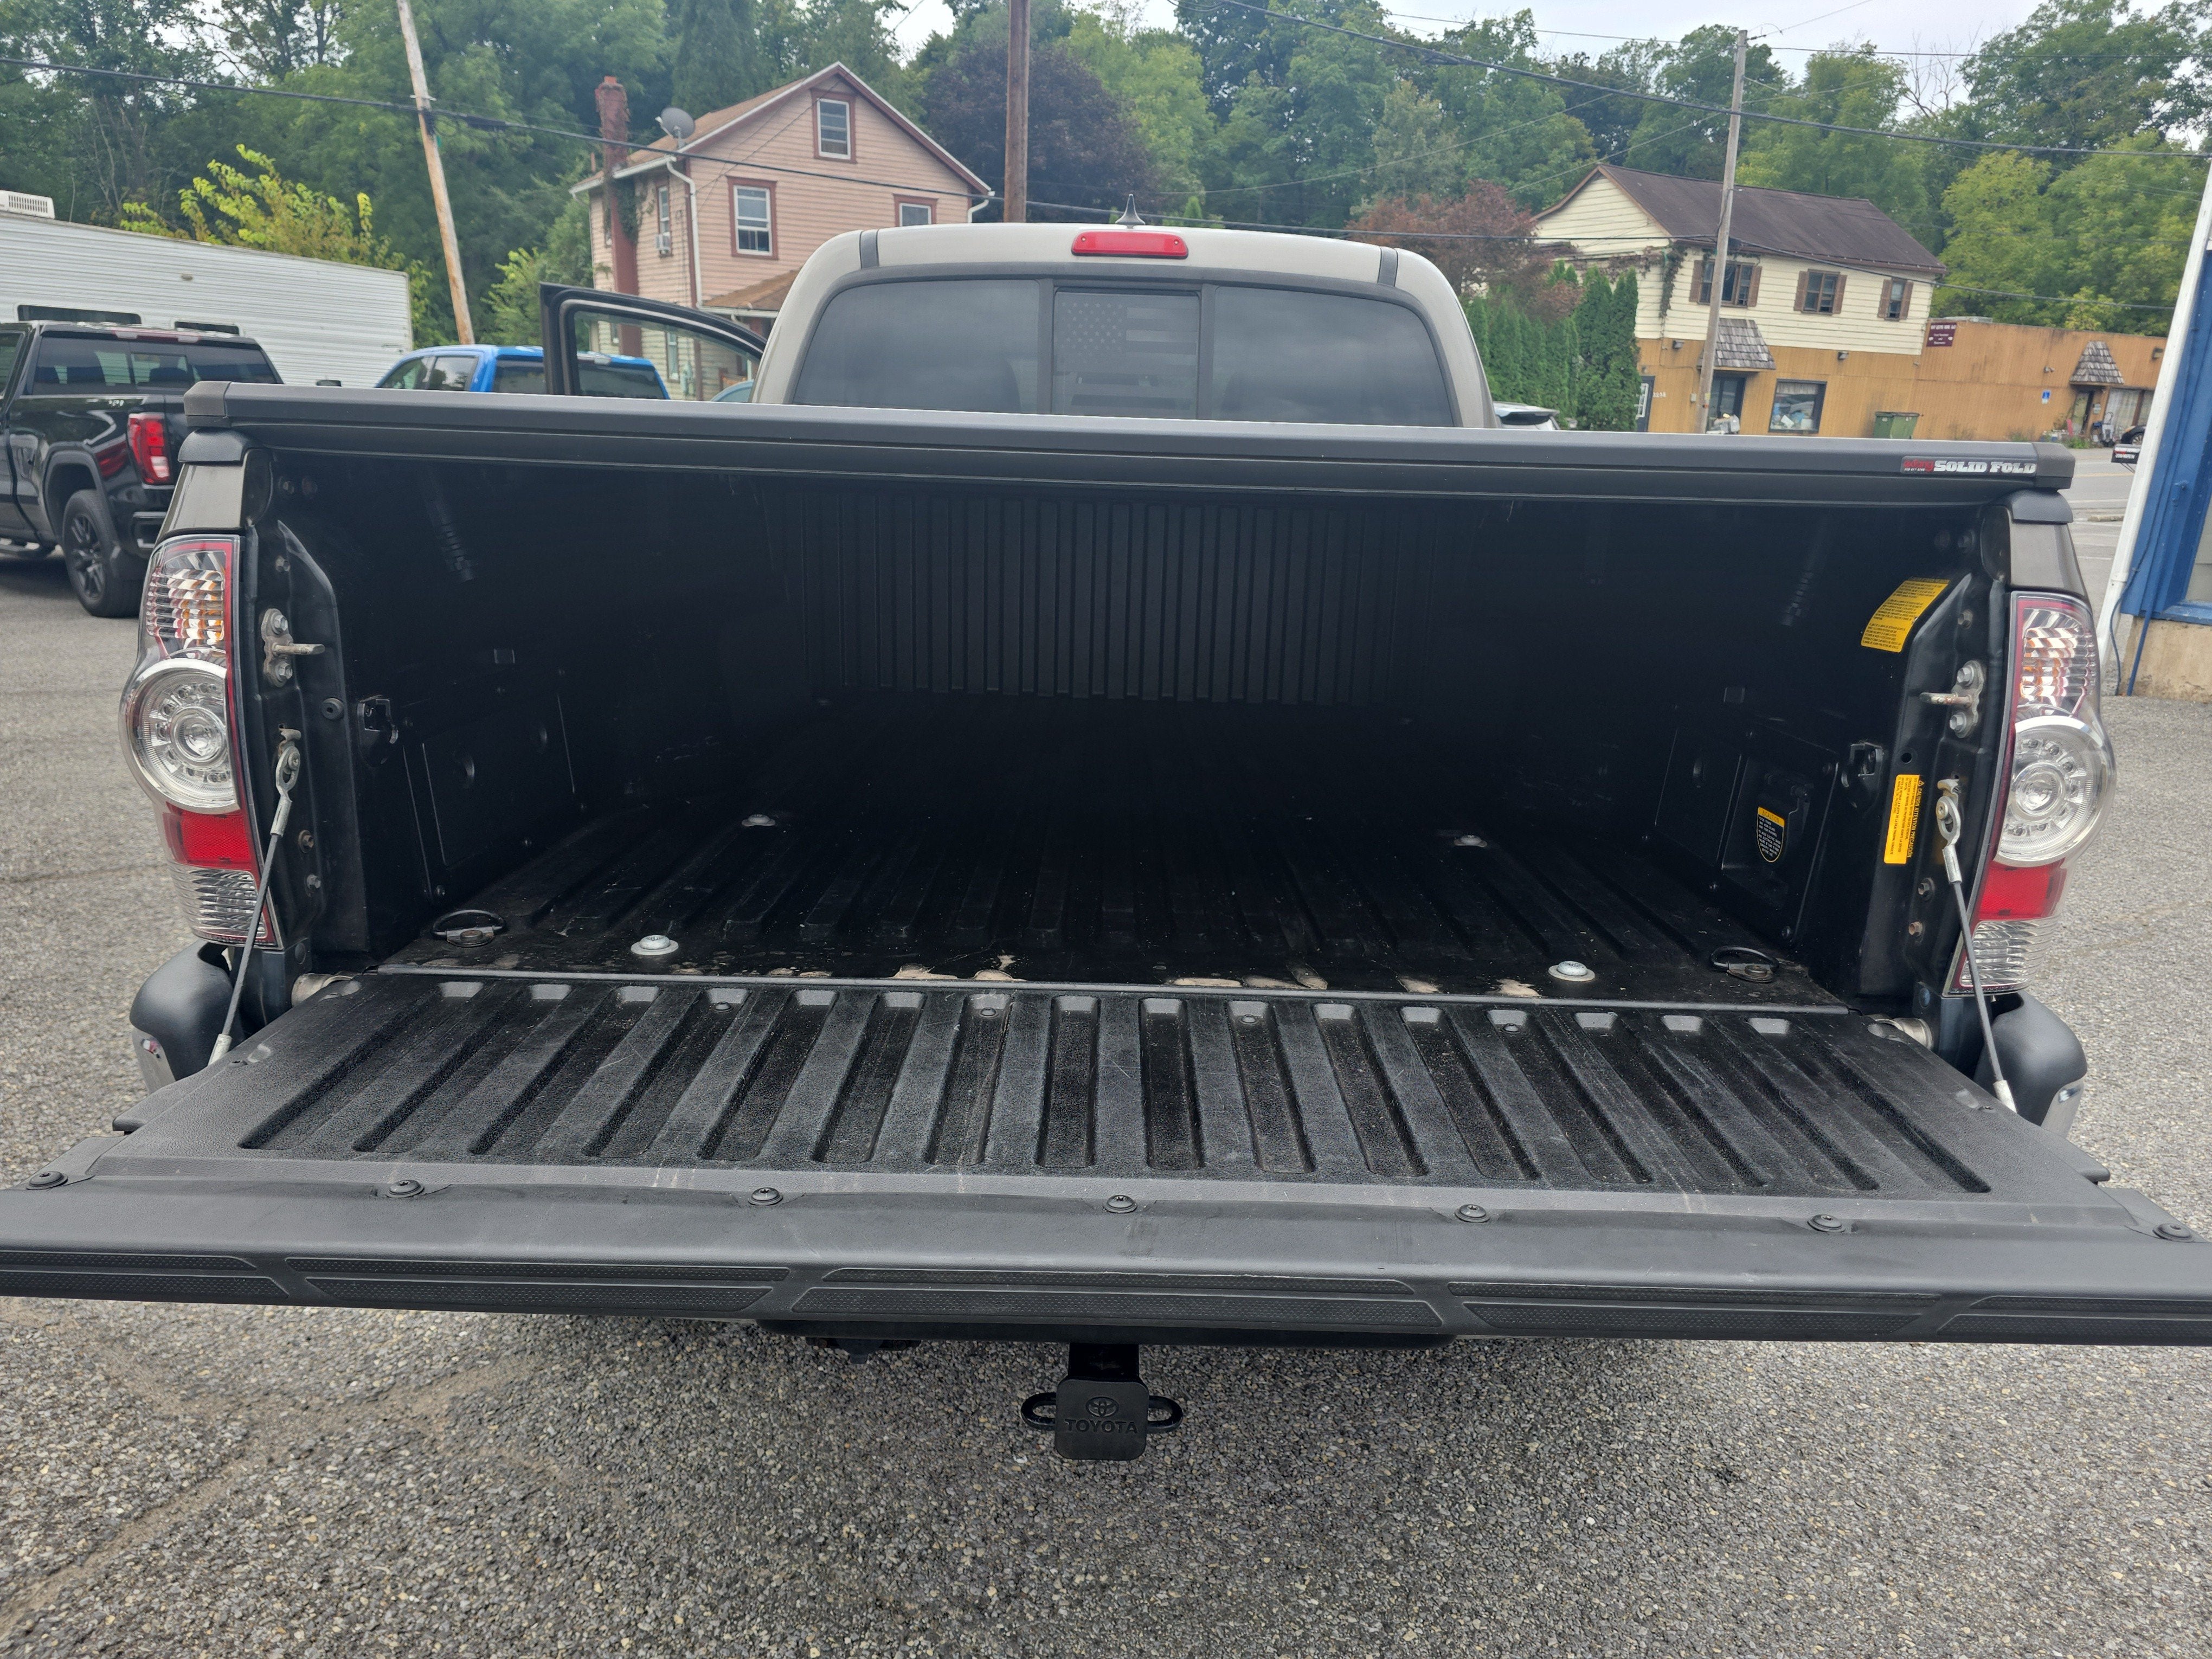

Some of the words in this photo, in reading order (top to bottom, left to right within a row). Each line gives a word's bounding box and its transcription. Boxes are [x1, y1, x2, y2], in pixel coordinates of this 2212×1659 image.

[1933, 460, 1988, 473] SOLID
[1989, 461, 2037, 474] FOLD
[1064, 1418, 1137, 1434] TOYOTA
